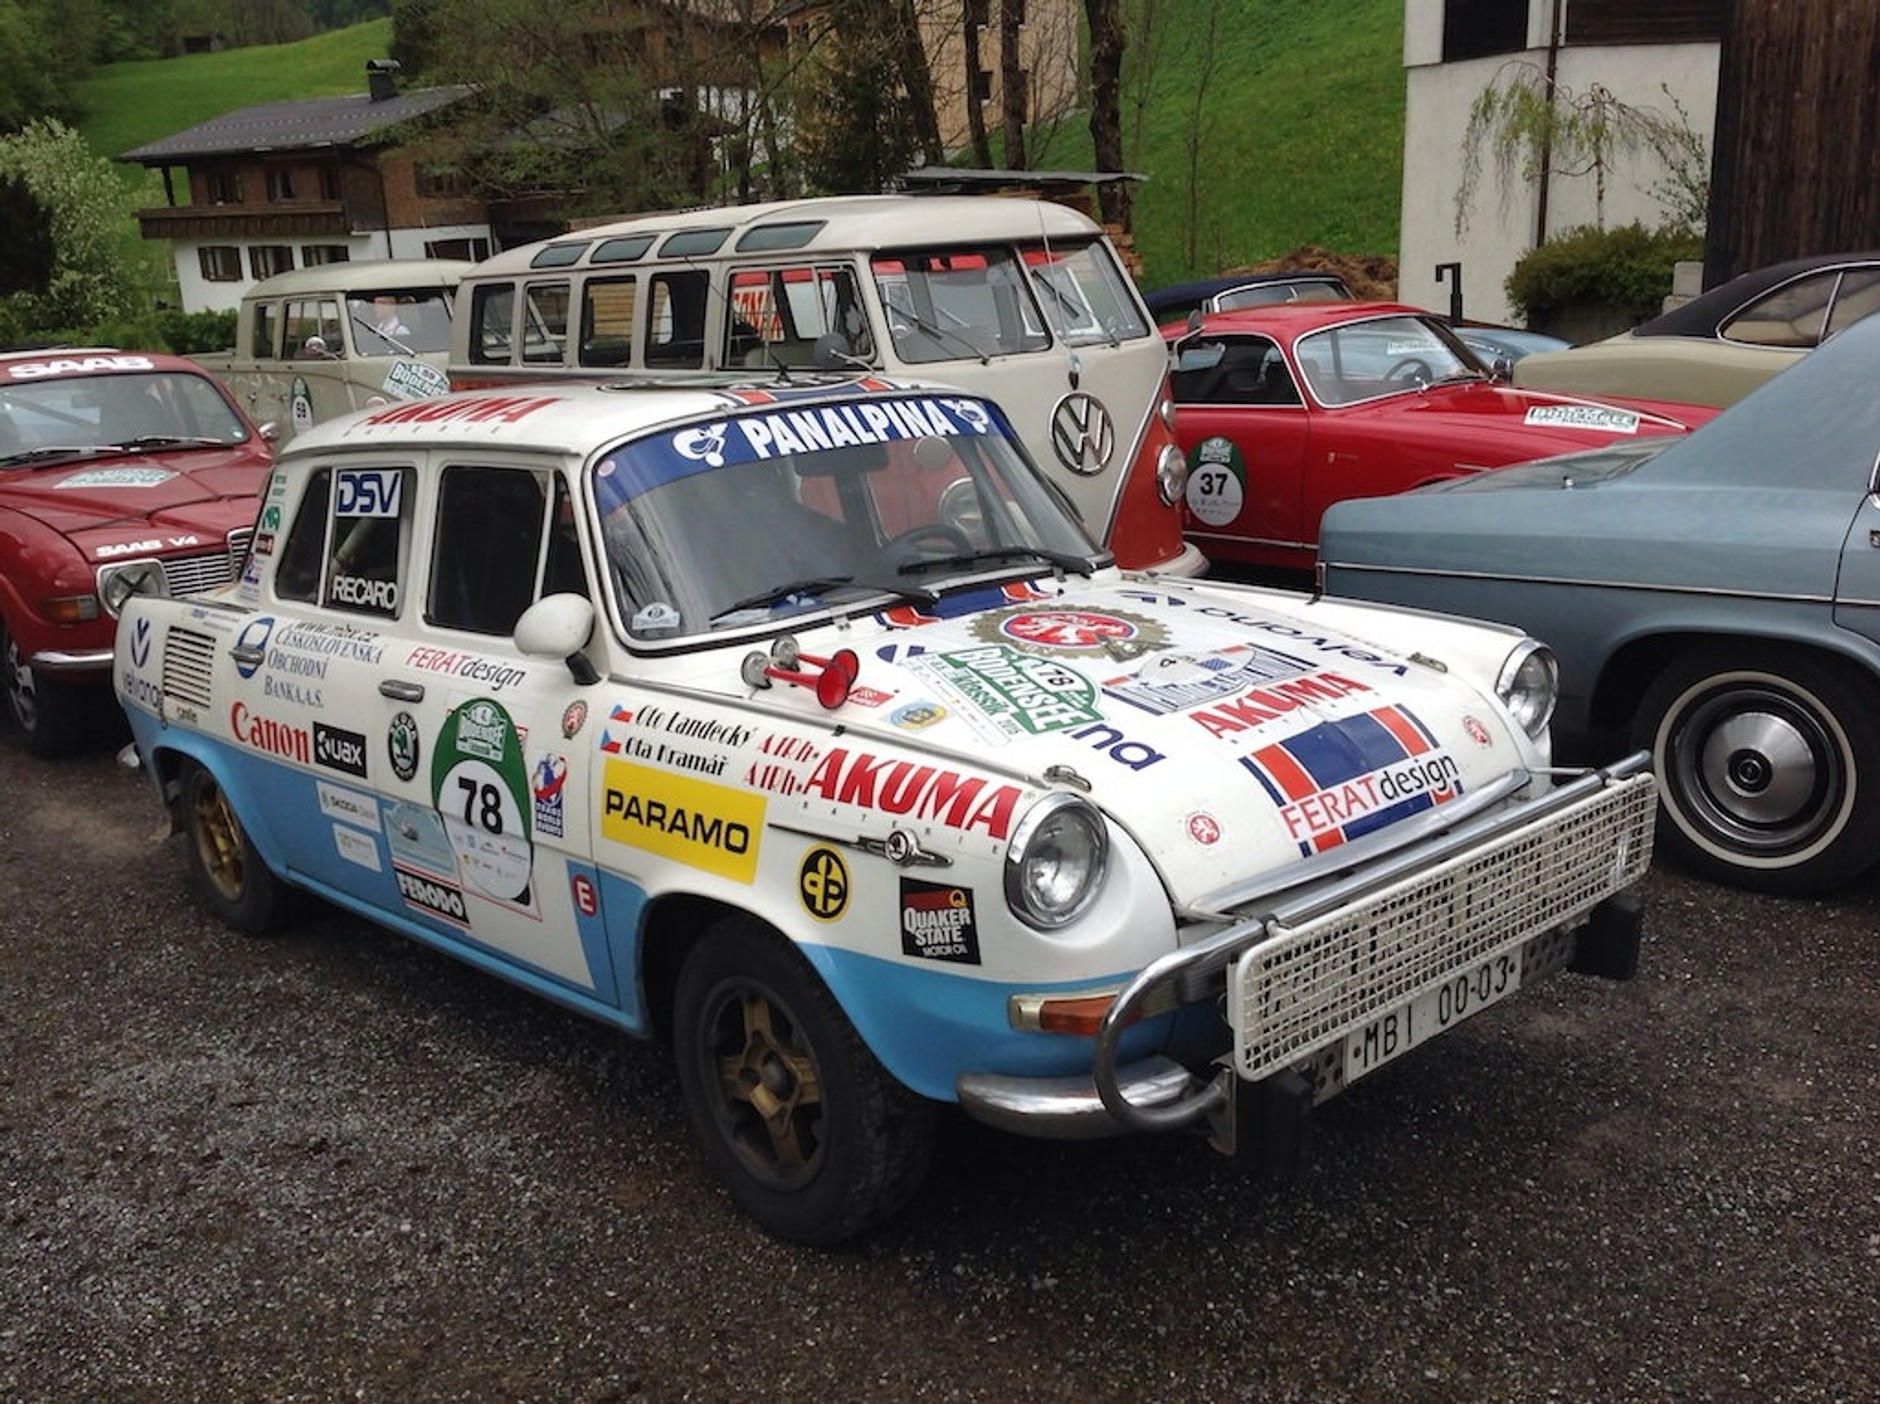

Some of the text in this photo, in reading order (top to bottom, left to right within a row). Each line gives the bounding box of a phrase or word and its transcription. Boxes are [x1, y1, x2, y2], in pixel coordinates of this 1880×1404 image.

[8, 356, 154, 379] SAAB
[738, 399, 959, 459] PANALPINA
[337, 473, 399, 513] DSV
[1200, 473, 1228, 496] 37
[97, 535, 199, 557] SAAB V4
[332, 576, 398, 610] RECARO
[405, 646, 526, 691] FERATdesign
[952, 647, 1096, 731] BODENSEE
[1038, 669, 1075, 686] 78
[1189, 672, 1374, 740] AKUMA
[231, 702, 310, 764] Canon
[666, 711, 757, 748] Landecký
[458, 776, 502, 834] 78
[803, 748, 1023, 841] AKUMA
[1280, 753, 1459, 839] FERATdesign
[606, 788, 750, 855] PARAMO
[398, 871, 464, 917] FERODO
[576, 881, 593, 913] E
[915, 925, 964, 947] STATE
[1438, 956, 1510, 1026] 00-03
